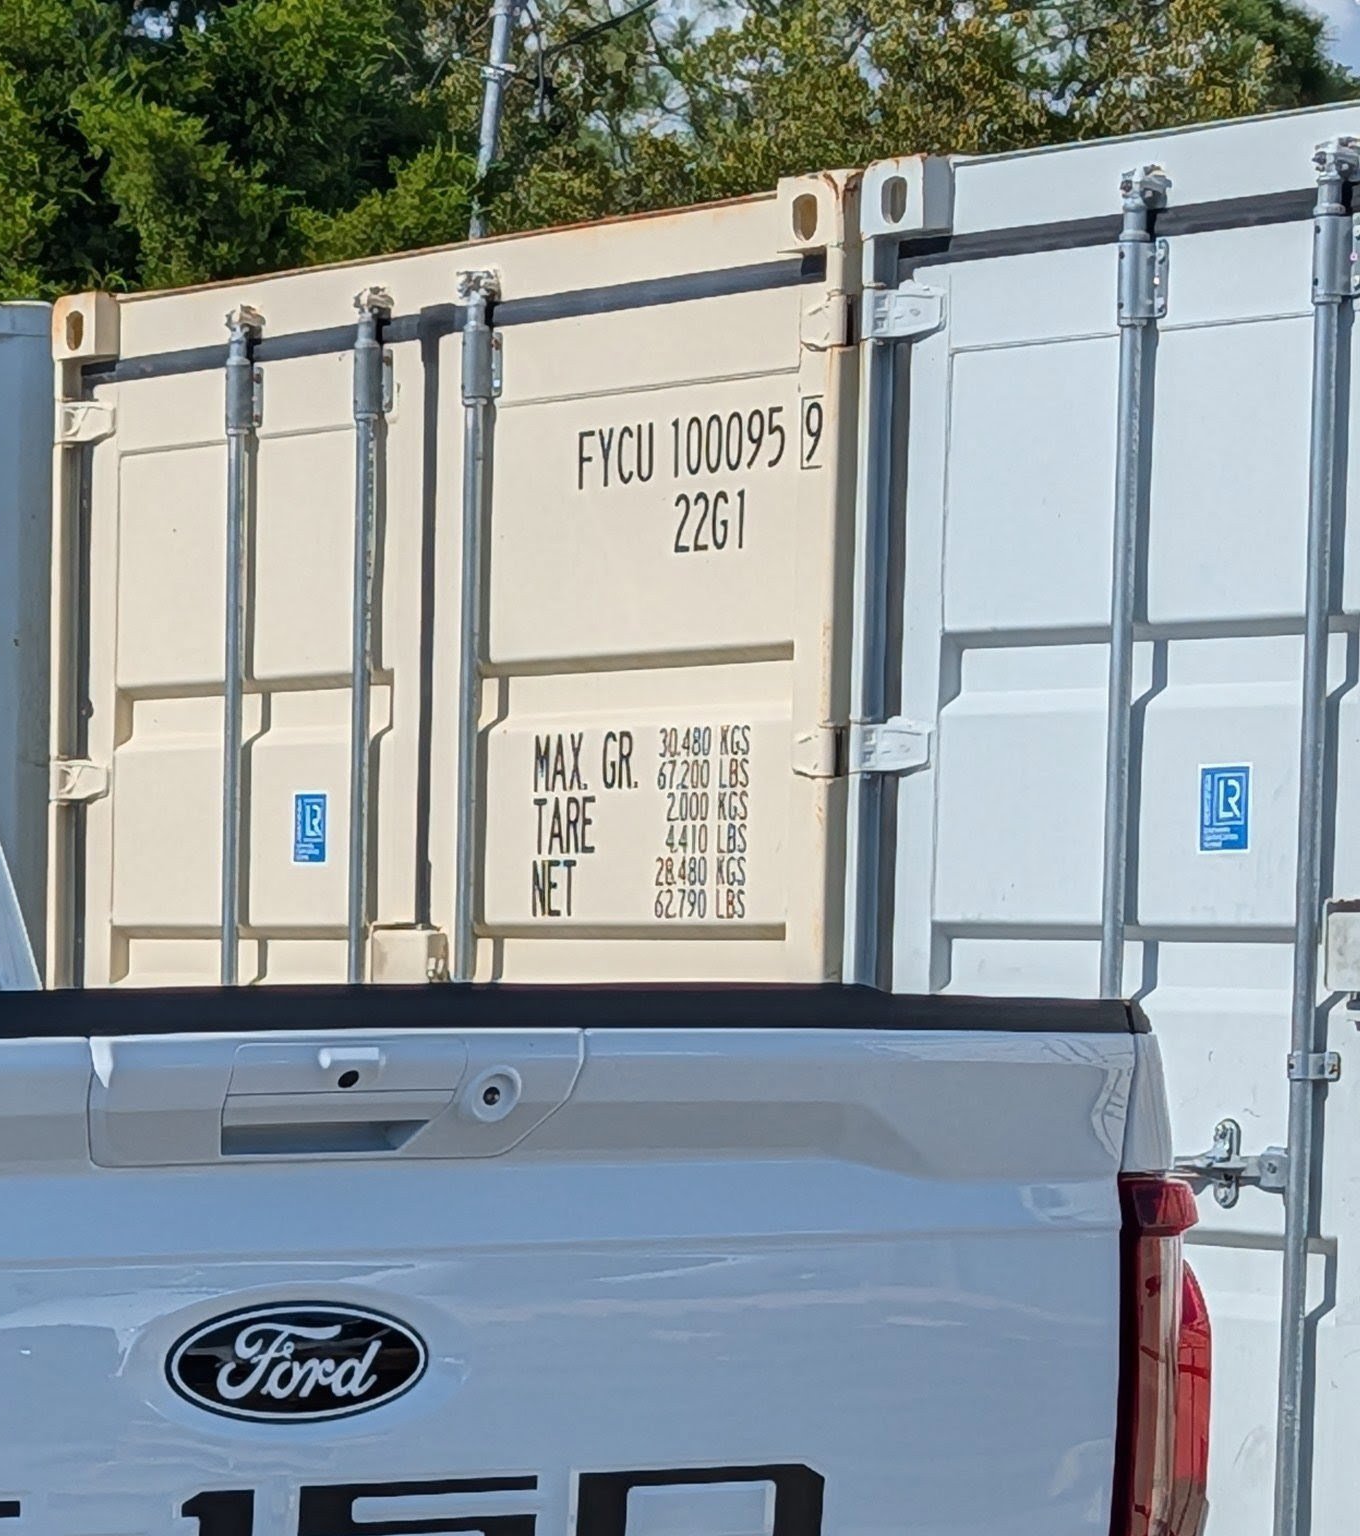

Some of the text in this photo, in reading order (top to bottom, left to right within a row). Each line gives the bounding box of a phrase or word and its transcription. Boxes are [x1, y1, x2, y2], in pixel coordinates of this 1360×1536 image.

[578, 401, 823, 490] FYCU 100095 9
[673, 490, 746, 553] 22G1
[534, 725, 750, 792] MAX. GR. 30.480 KGS
[718, 758, 749, 788] LBS
[533, 796, 596, 855] TARE
[717, 790, 748, 821] KGS
[716, 823, 747, 853] LBS
[532, 860, 577, 918] NET
[716, 856, 746, 886] KGS
[716, 888, 745, 919] LBS
[215, 1322, 382, 1400] Ford
